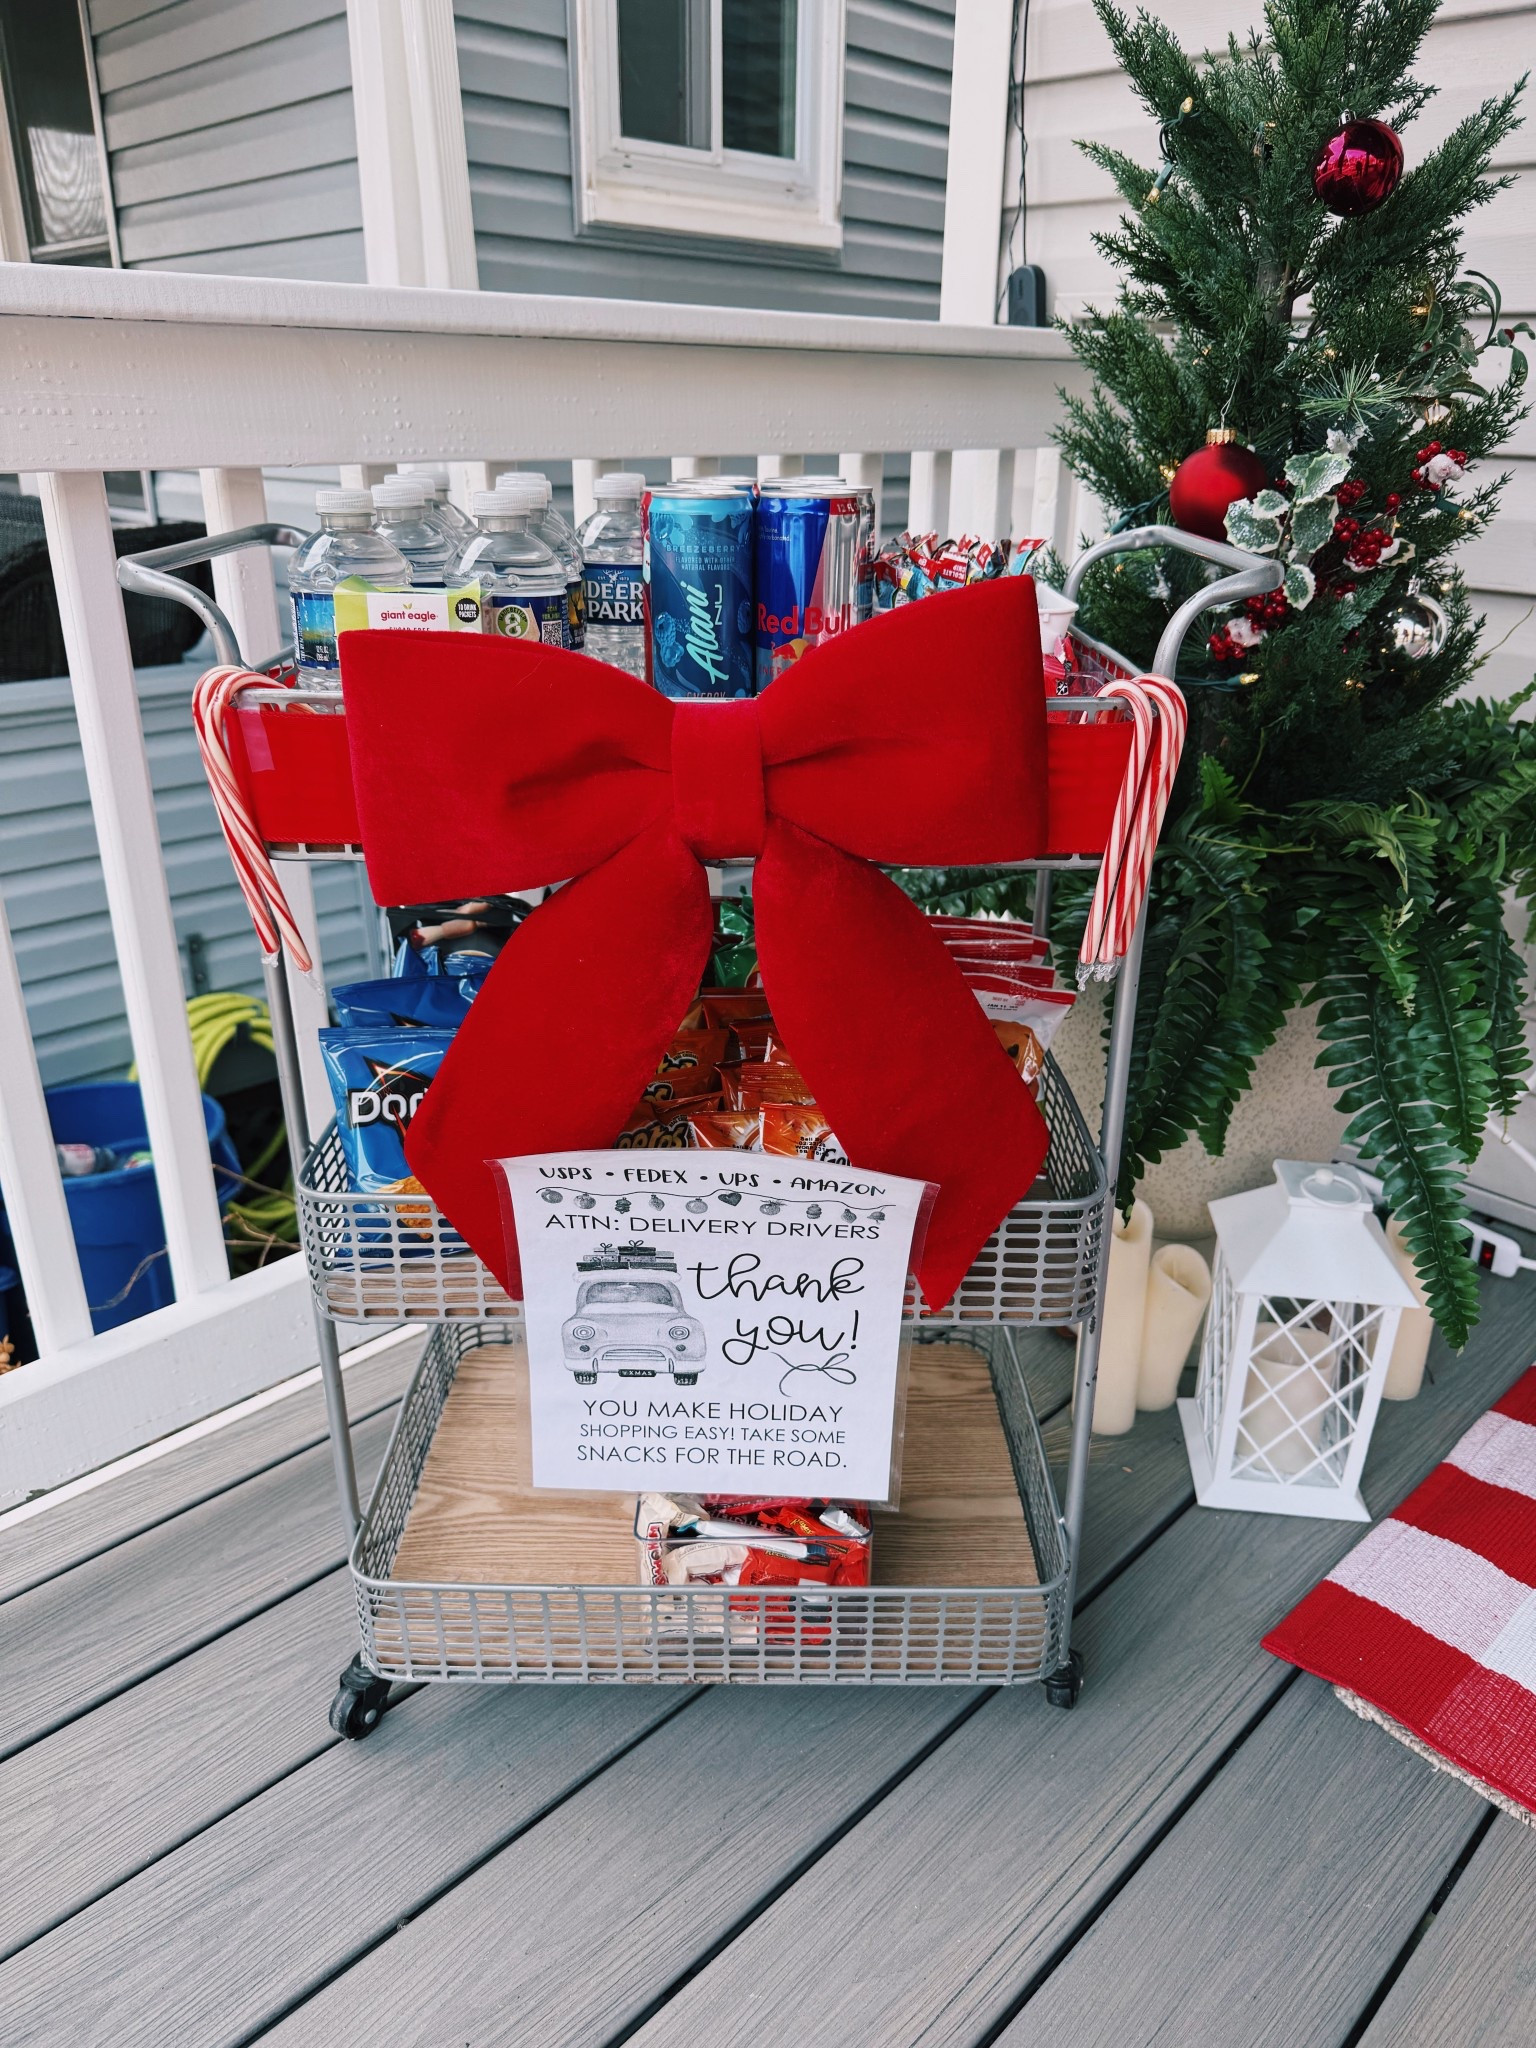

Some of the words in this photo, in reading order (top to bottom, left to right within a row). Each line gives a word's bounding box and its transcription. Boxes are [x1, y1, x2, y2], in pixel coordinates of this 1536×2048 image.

[587, 580, 643, 600] DEER
[380, 610, 406, 622] giant
[407, 610, 436, 623] eagle
[588, 600, 644, 622] PARK
[758, 603, 798, 635] Red
[805, 603, 851, 635] Bull
[681, 580, 730, 685] Alani
[351, 1089, 426, 1124] Dor
[539, 1167, 592, 1181] USPS
[623, 1168, 688, 1184] FEDEX
[718, 1173, 759, 1188] UPS
[789, 1177, 886, 1197] AMAZON
[545, 1213, 620, 1231] ATTN:
[629, 1217, 757, 1235] DELIVERY
[767, 1221, 881, 1240] DRIVERS
[686, 1252, 865, 1304] thank
[721, 1310, 860, 1365] you!
[583, 1400, 638, 1417] YOU
[647, 1402, 721, 1419] MAKE
[729, 1403, 843, 1423] HOLIDAY
[580, 1424, 678, 1439] SHOPPING
[685, 1427, 734, 1441] EASY!
[740, 1428, 785, 1442] TAKE
[790, 1430, 846, 1444] SOME
[577, 1445, 667, 1463] SNACKS
[675, 1448, 720, 1464] FOR
[726, 1448, 765, 1466] THE
[773, 1450, 847, 1468] ROAD.
